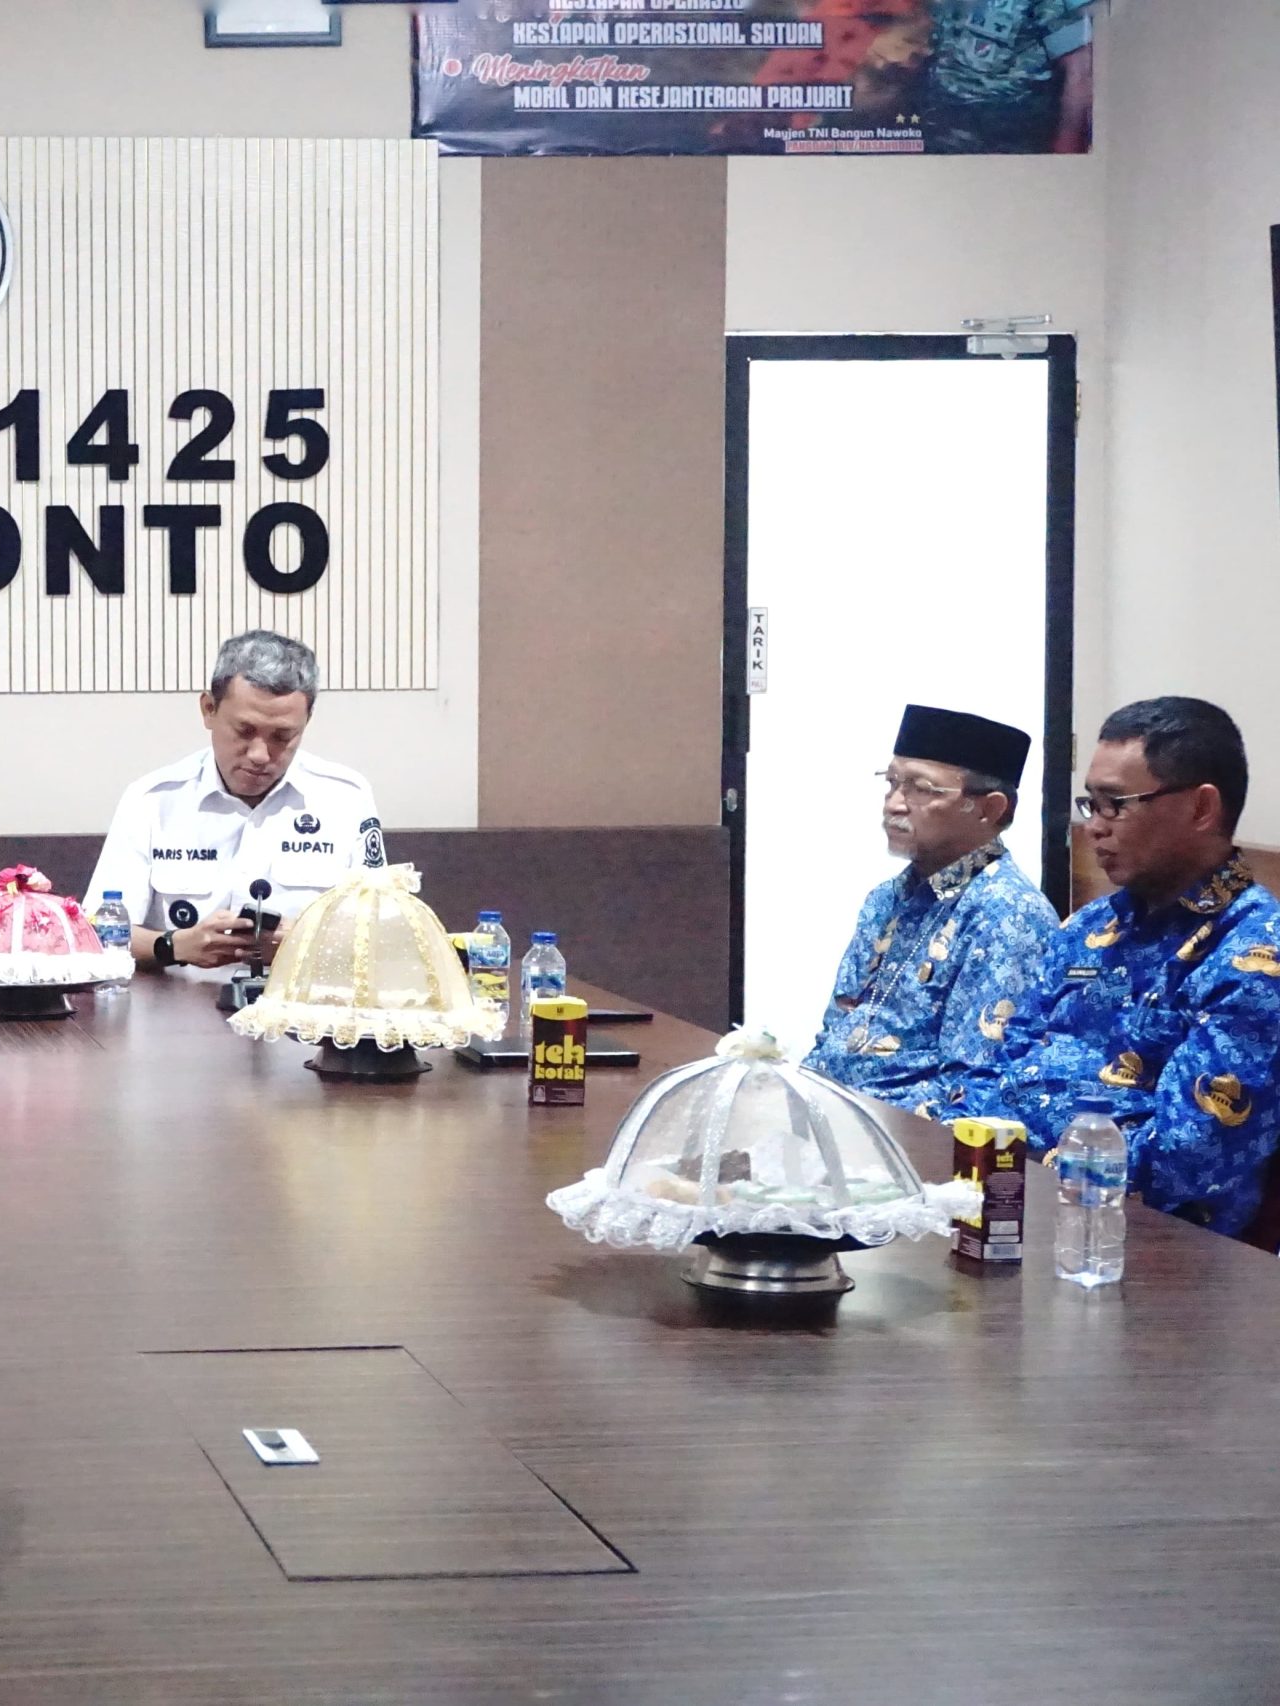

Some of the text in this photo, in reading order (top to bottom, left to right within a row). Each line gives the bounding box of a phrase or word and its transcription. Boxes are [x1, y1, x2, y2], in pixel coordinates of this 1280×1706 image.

[514, 22, 823, 44] KESIAPAN OPERASIONAL SATUAN
[472, 52, 651, 88] Meningkatkan
[514, 85, 853, 108] MORIL DAN KESEJAHTERAAN PRAJURIT
[764, 127, 922, 141] Mayjen TNI Bangun Nawoko
[753, 613, 765, 670] TARIK
[152, 848, 218, 861] PARIS YASIR
[281, 841, 334, 854] BUPATI
[534, 1034, 585, 1065] teh
[534, 1065, 584, 1081] kotak
